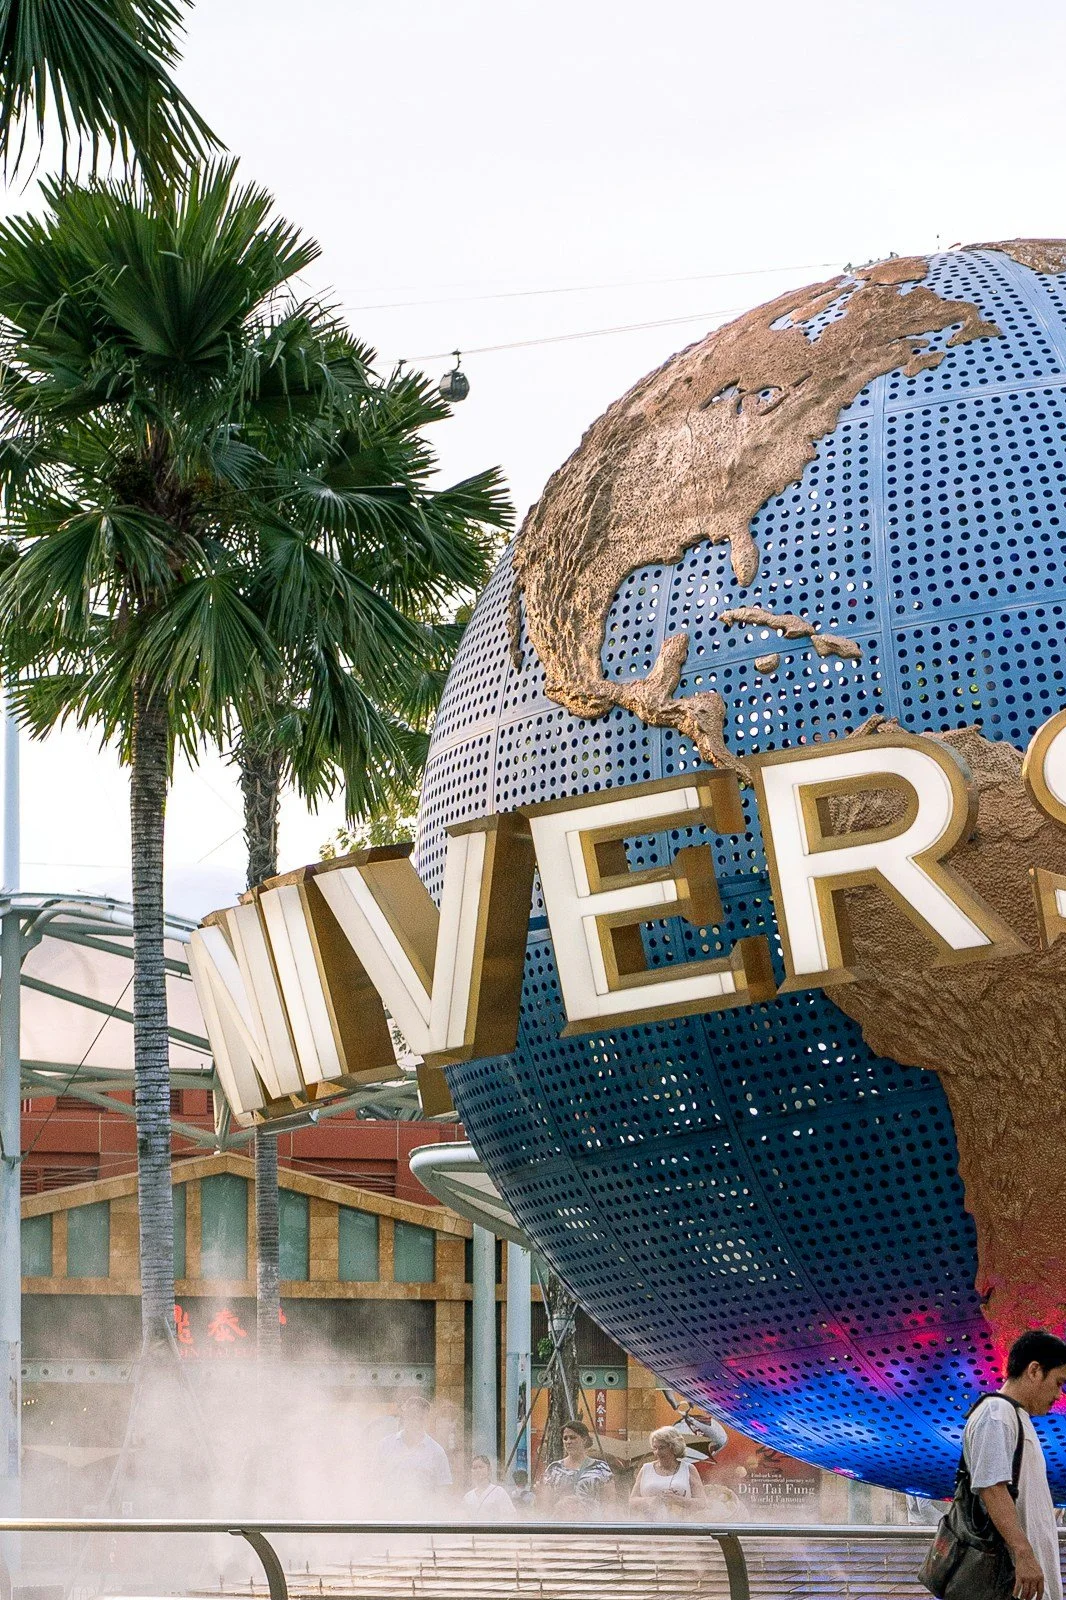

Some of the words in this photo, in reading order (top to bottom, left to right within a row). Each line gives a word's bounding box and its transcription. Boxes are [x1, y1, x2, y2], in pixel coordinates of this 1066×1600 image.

[738, 1483, 759, 1495] Din
[762, 1483, 782, 1495] Tai
[786, 1483, 815, 1496] Fung
[750, 1495, 773, 1503] World
